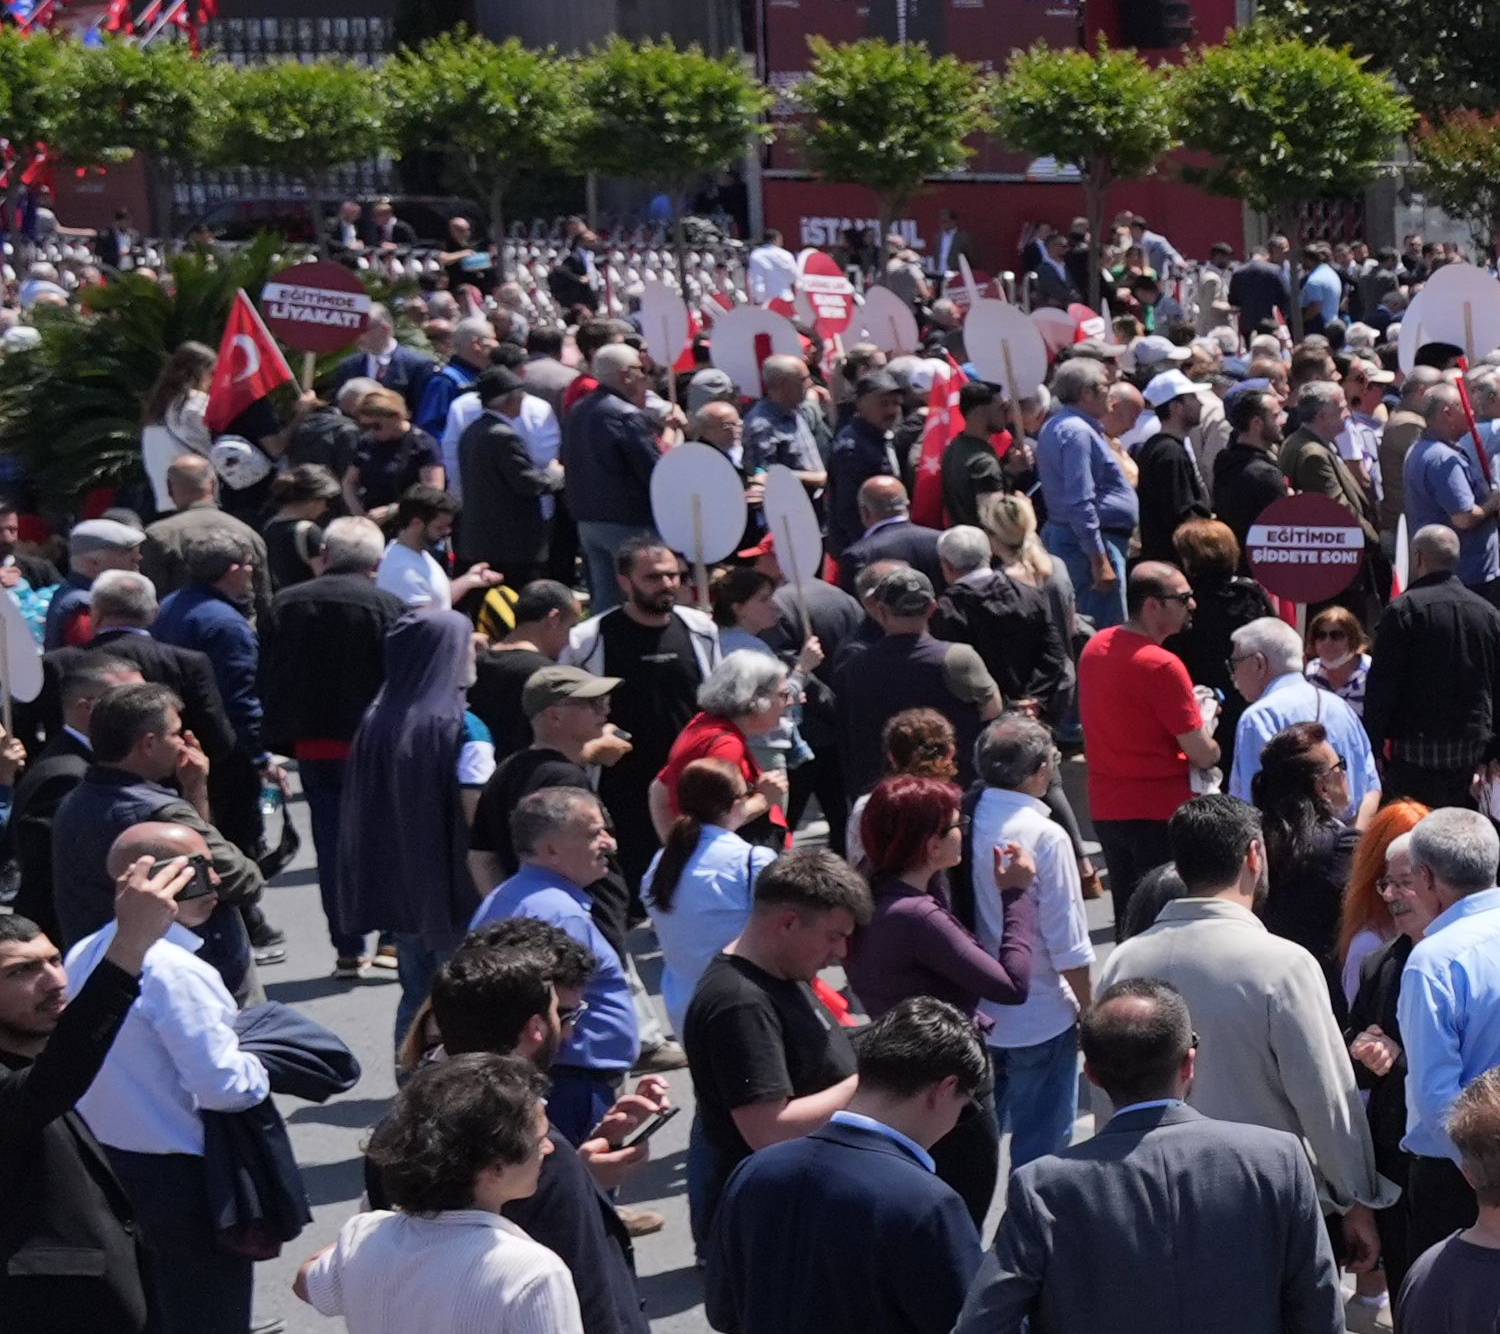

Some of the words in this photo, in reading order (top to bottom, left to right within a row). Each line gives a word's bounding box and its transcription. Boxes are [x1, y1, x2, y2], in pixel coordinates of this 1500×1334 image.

[1267, 528, 1346, 543] EĞİTİMDE
[1252, 547, 1318, 564] ŞİDDETE
[1321, 551, 1357, 564] SON!
